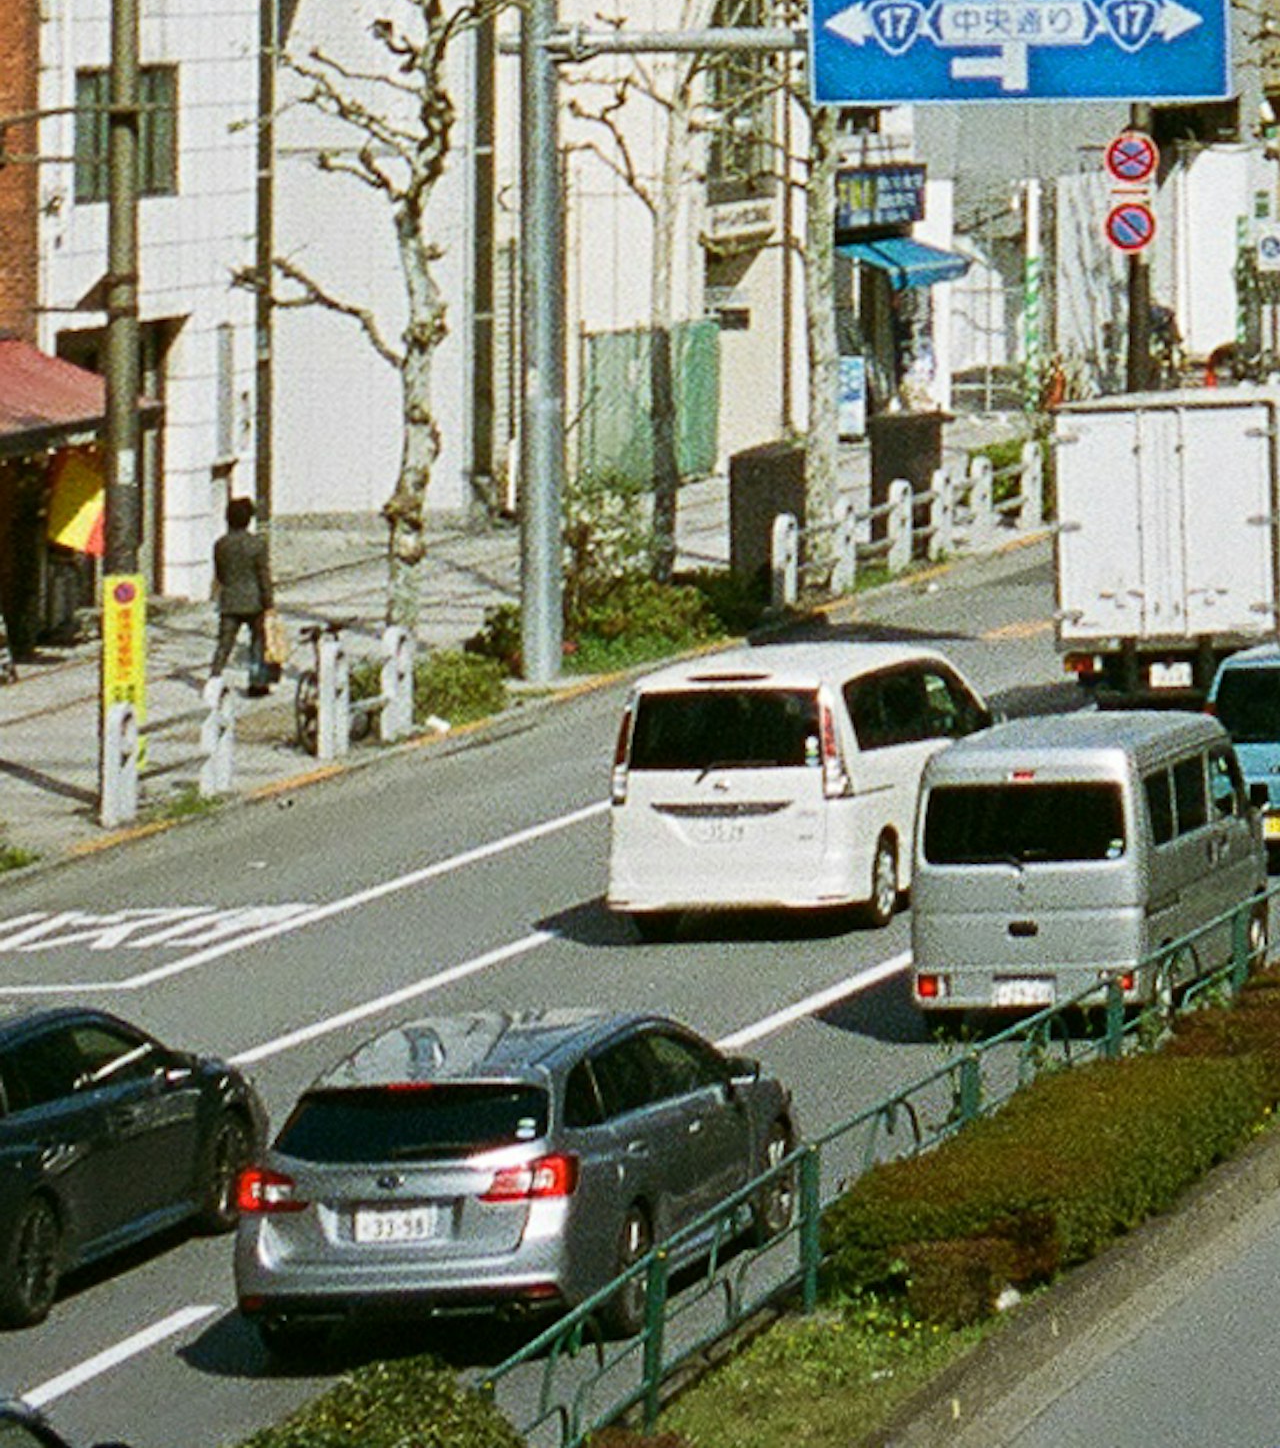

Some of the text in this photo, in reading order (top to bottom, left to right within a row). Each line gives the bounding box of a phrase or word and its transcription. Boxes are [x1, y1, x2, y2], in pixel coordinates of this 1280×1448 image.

[878, 8, 913, 39] 17
[952, 7, 1073, 34] 中央通り
[1112, 5, 1149, 36] 17
